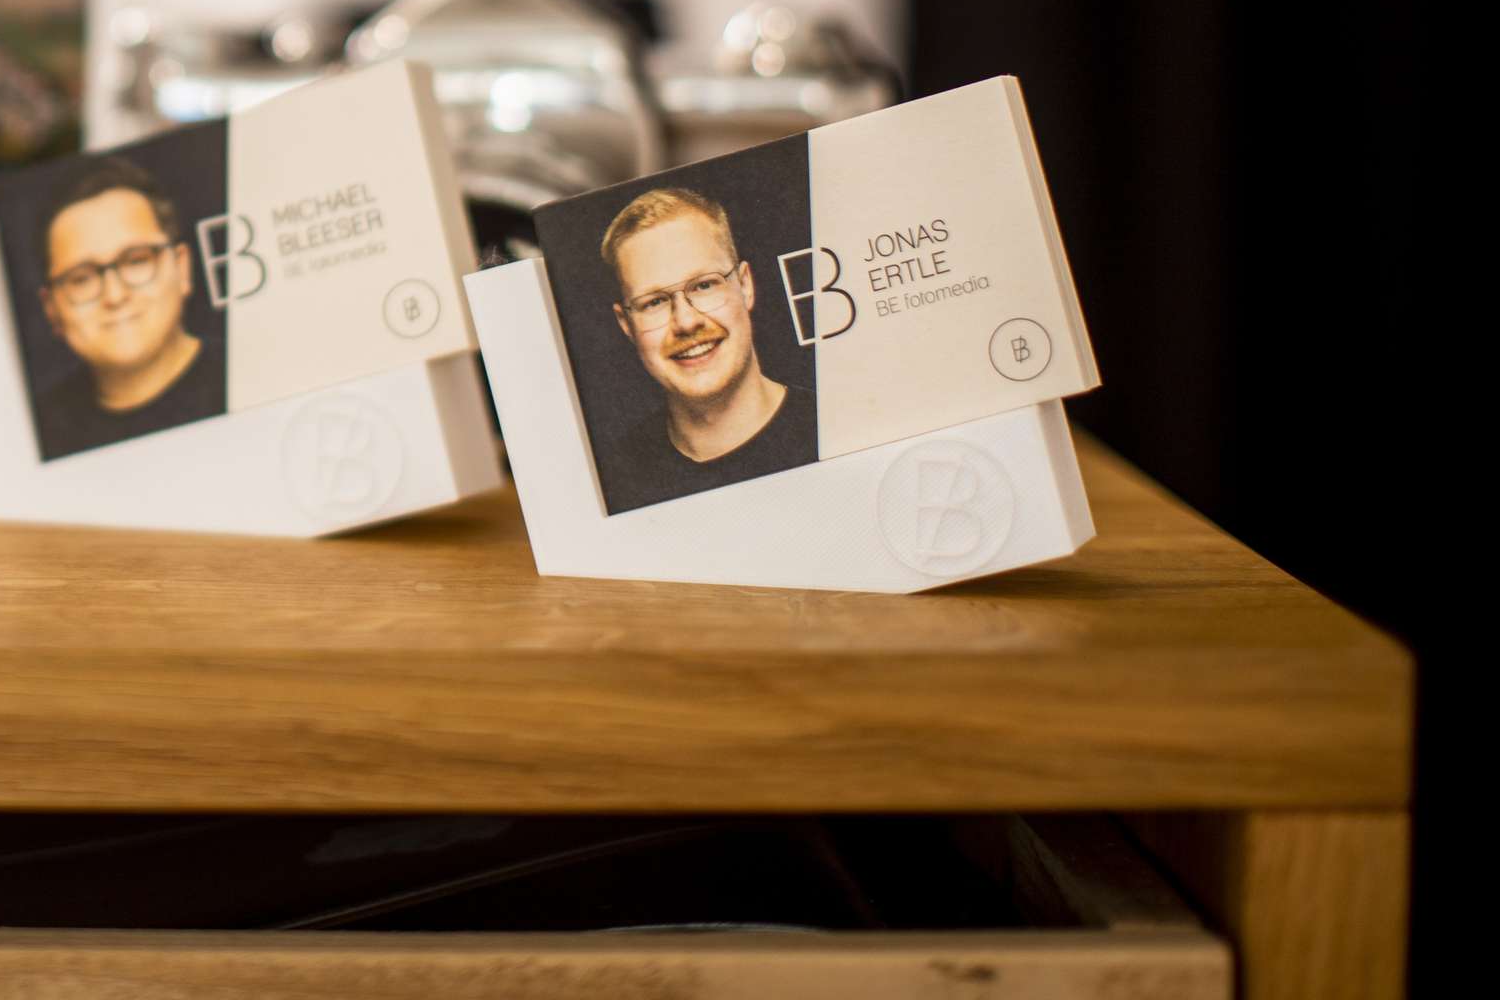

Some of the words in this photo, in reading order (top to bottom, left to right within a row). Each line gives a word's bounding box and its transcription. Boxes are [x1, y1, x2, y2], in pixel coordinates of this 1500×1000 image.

[271, 182, 377, 228] MICHAEL
[276, 208, 385, 257] BLEESER
[864, 219, 950, 263] JONAS
[867, 249, 951, 292] ERTLE
[875, 298, 902, 318] BE
[904, 273, 991, 311] fotomedia
